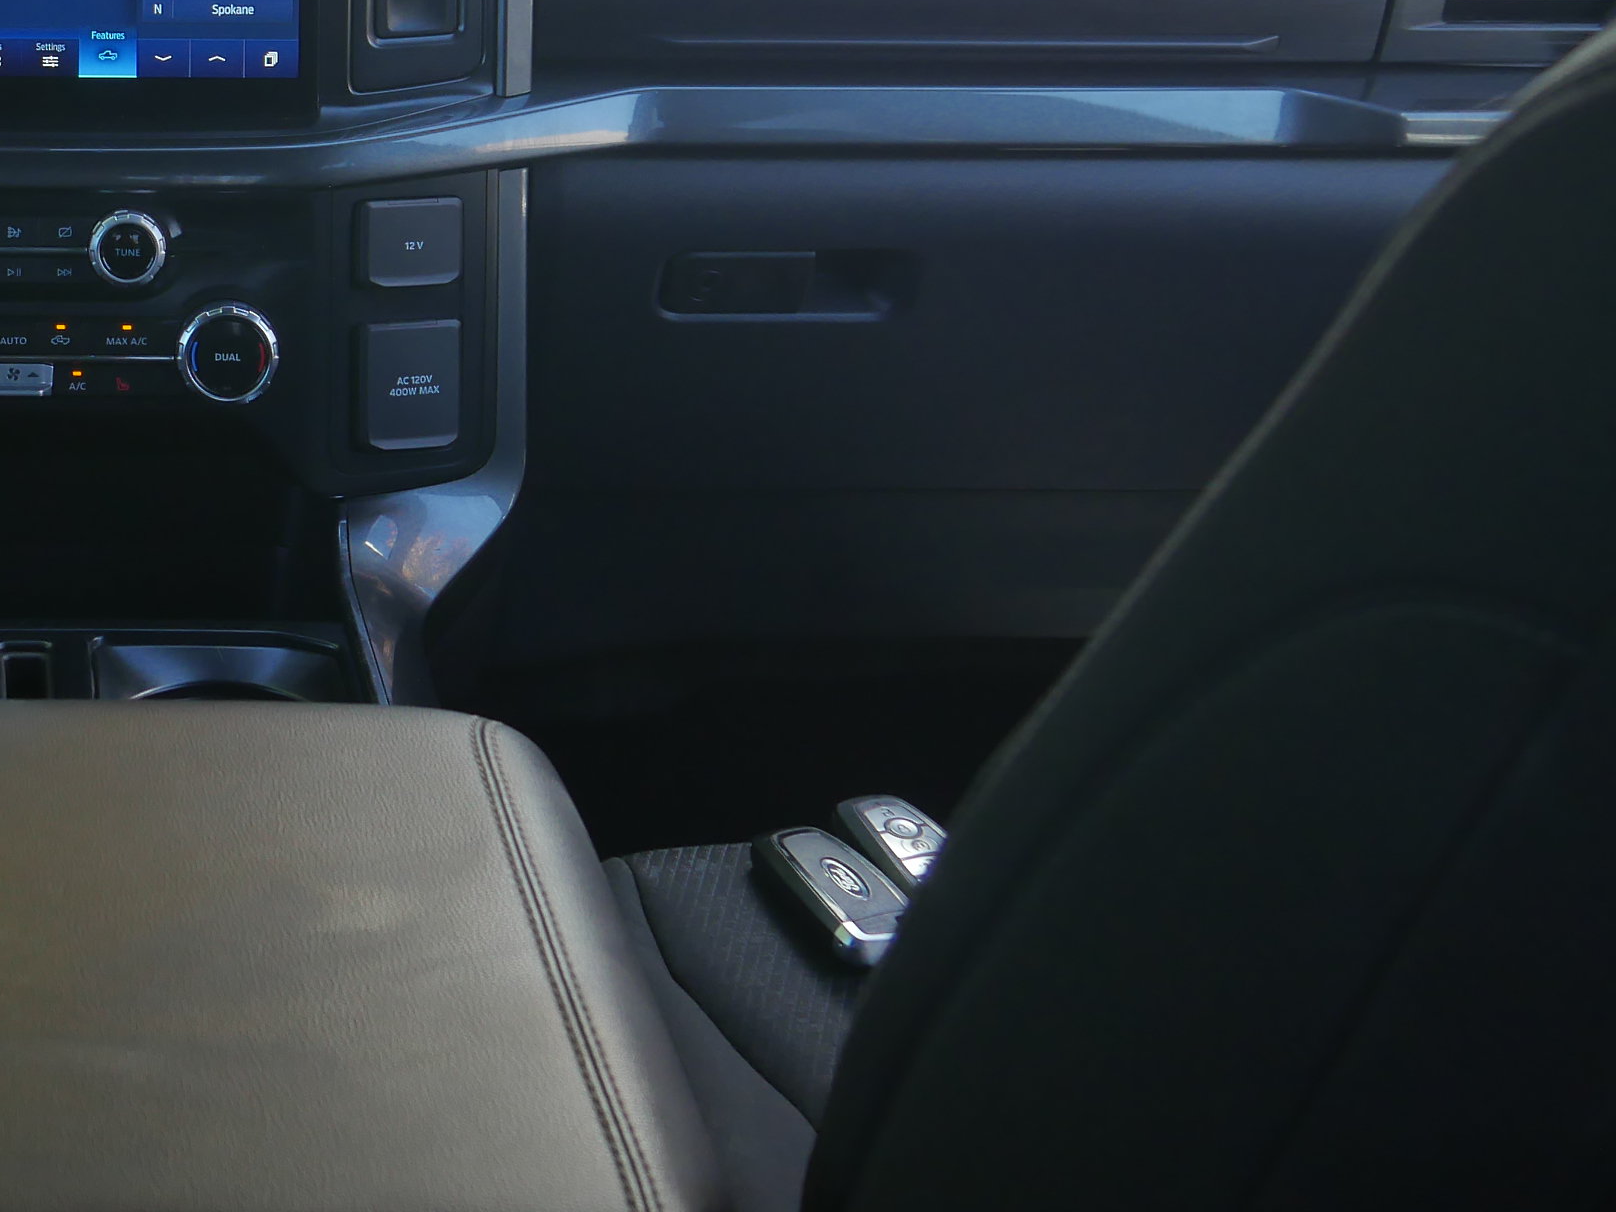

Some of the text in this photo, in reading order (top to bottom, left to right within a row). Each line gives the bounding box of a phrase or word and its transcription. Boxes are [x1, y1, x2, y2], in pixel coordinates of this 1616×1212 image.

[153, 4, 163, 15] N
[212, 3, 255, 16] Spokane
[91, 30, 125, 40] Features
[35, 42, 66, 53] Settings
[404, 241, 424, 251] 12 V
[115, 247, 141, 257] TUNE
[0, 336, 28, 345] AUTO
[106, 336, 149, 346] MAX A/C
[214, 352, 241, 362] DUAL
[396, 374, 433, 386] AC 120V
[68, 381, 87, 391] A/C
[389, 385, 440, 397] 400W MAX
